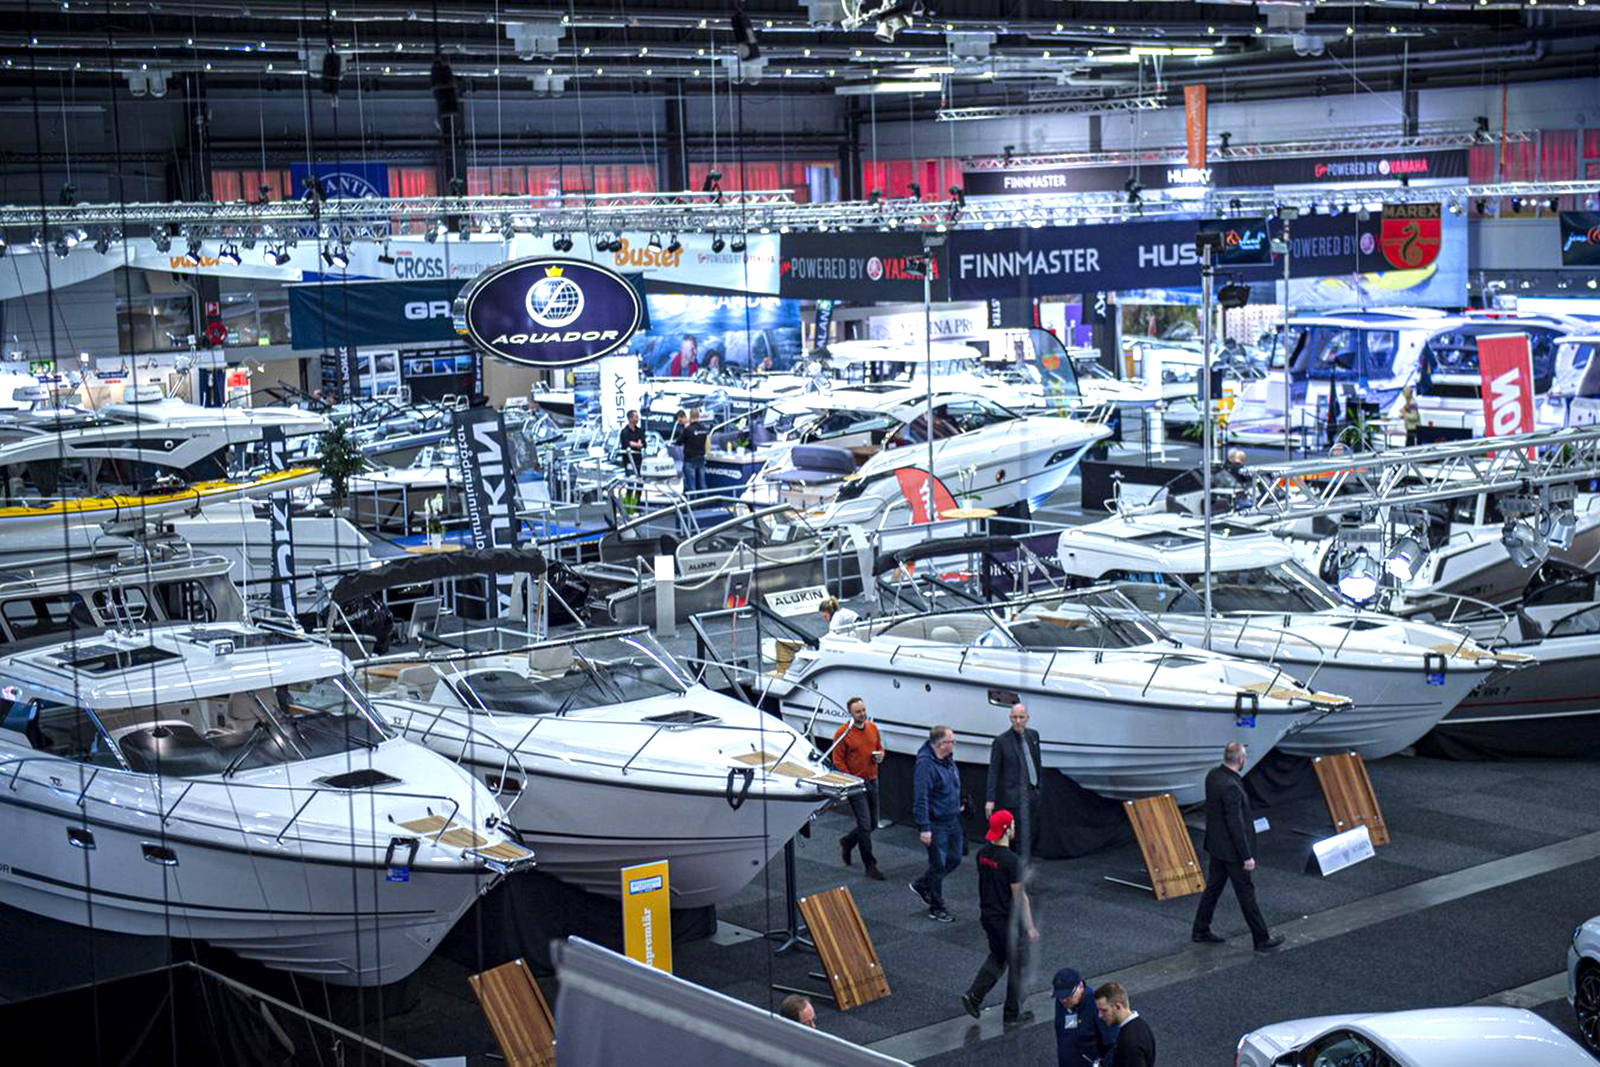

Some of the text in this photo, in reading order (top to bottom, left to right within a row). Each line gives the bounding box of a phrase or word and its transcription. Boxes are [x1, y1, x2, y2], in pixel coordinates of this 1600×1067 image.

[1327, 162, 1365, 176] POWERED
[1367, 161, 1378, 175] BY
[1390, 158, 1428, 173] YAMAHA
[1004, 174, 1067, 189] FINNMASTER
[1167, 168, 1213, 184] HUSKY
[1383, 204, 1440, 217] MAREX
[394, 257, 445, 279] CROSS
[791, 257, 846, 279] POWERED
[849, 257, 865, 279] BY
[960, 248, 1100, 279] FINNMASTER
[491, 330, 619, 346] AQUADOR
[689, 561, 717, 571] ALUKIN
[775, 590, 824, 607] ALUKIN
[824, 709, 848, 719] AQU
